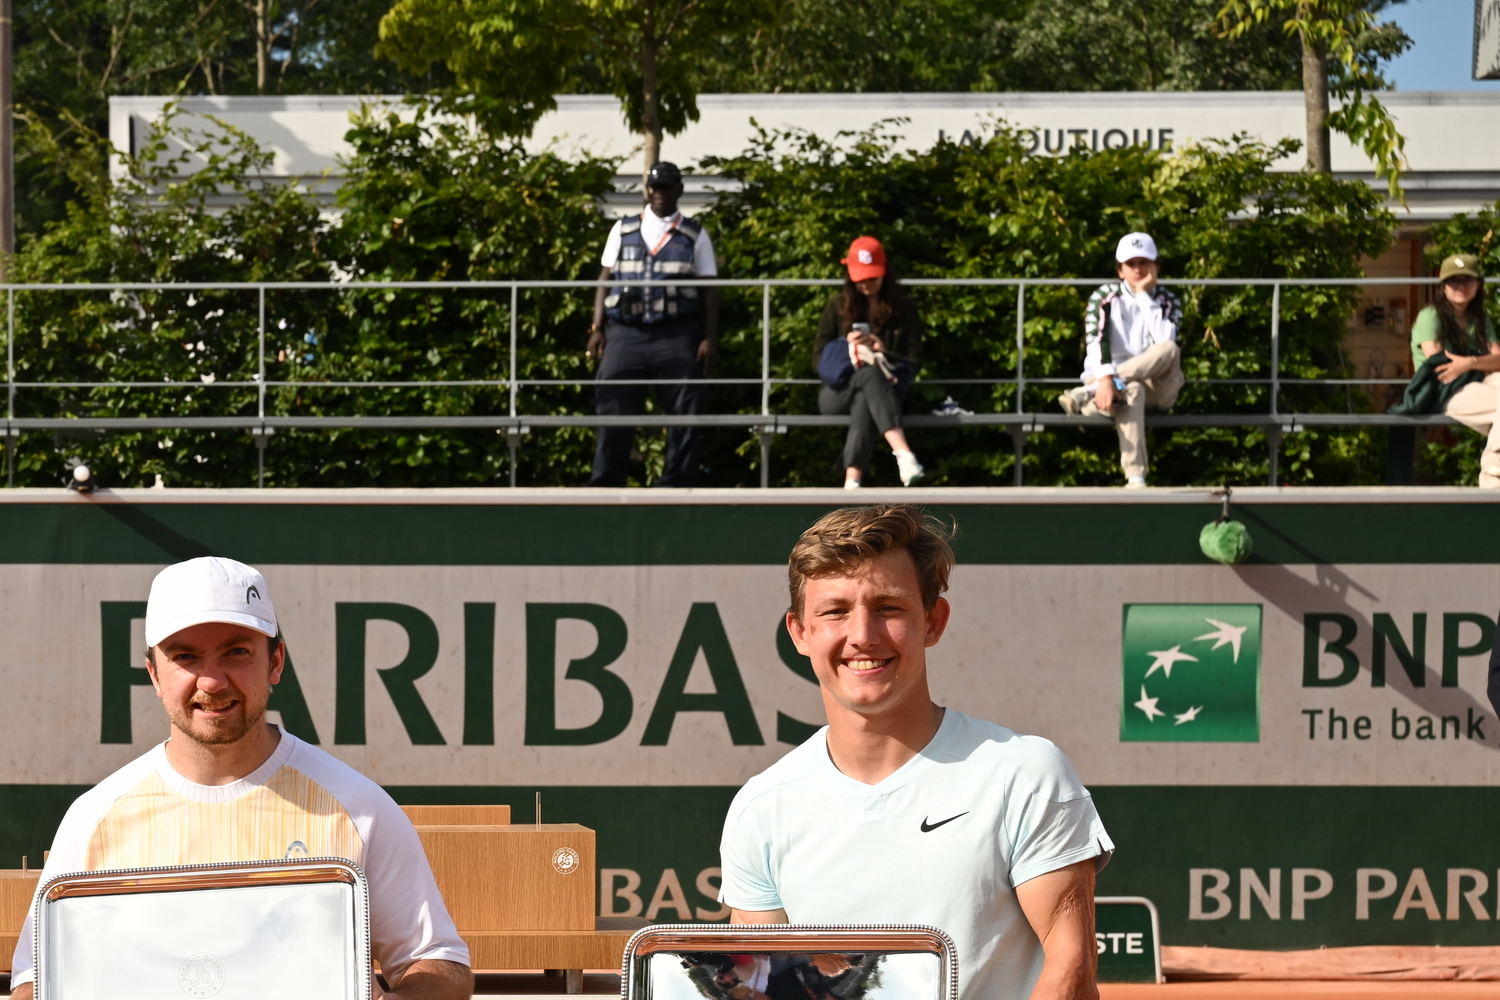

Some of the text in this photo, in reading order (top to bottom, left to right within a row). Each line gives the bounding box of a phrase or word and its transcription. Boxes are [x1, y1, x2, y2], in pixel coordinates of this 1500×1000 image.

[1302, 612, 1497, 688] BNP
[1302, 707, 1486, 740] The bank
[1188, 868, 1334, 921] BNP
[1095, 932, 1144, 954] STE
[180, 955, 201, 982] ROLAND
